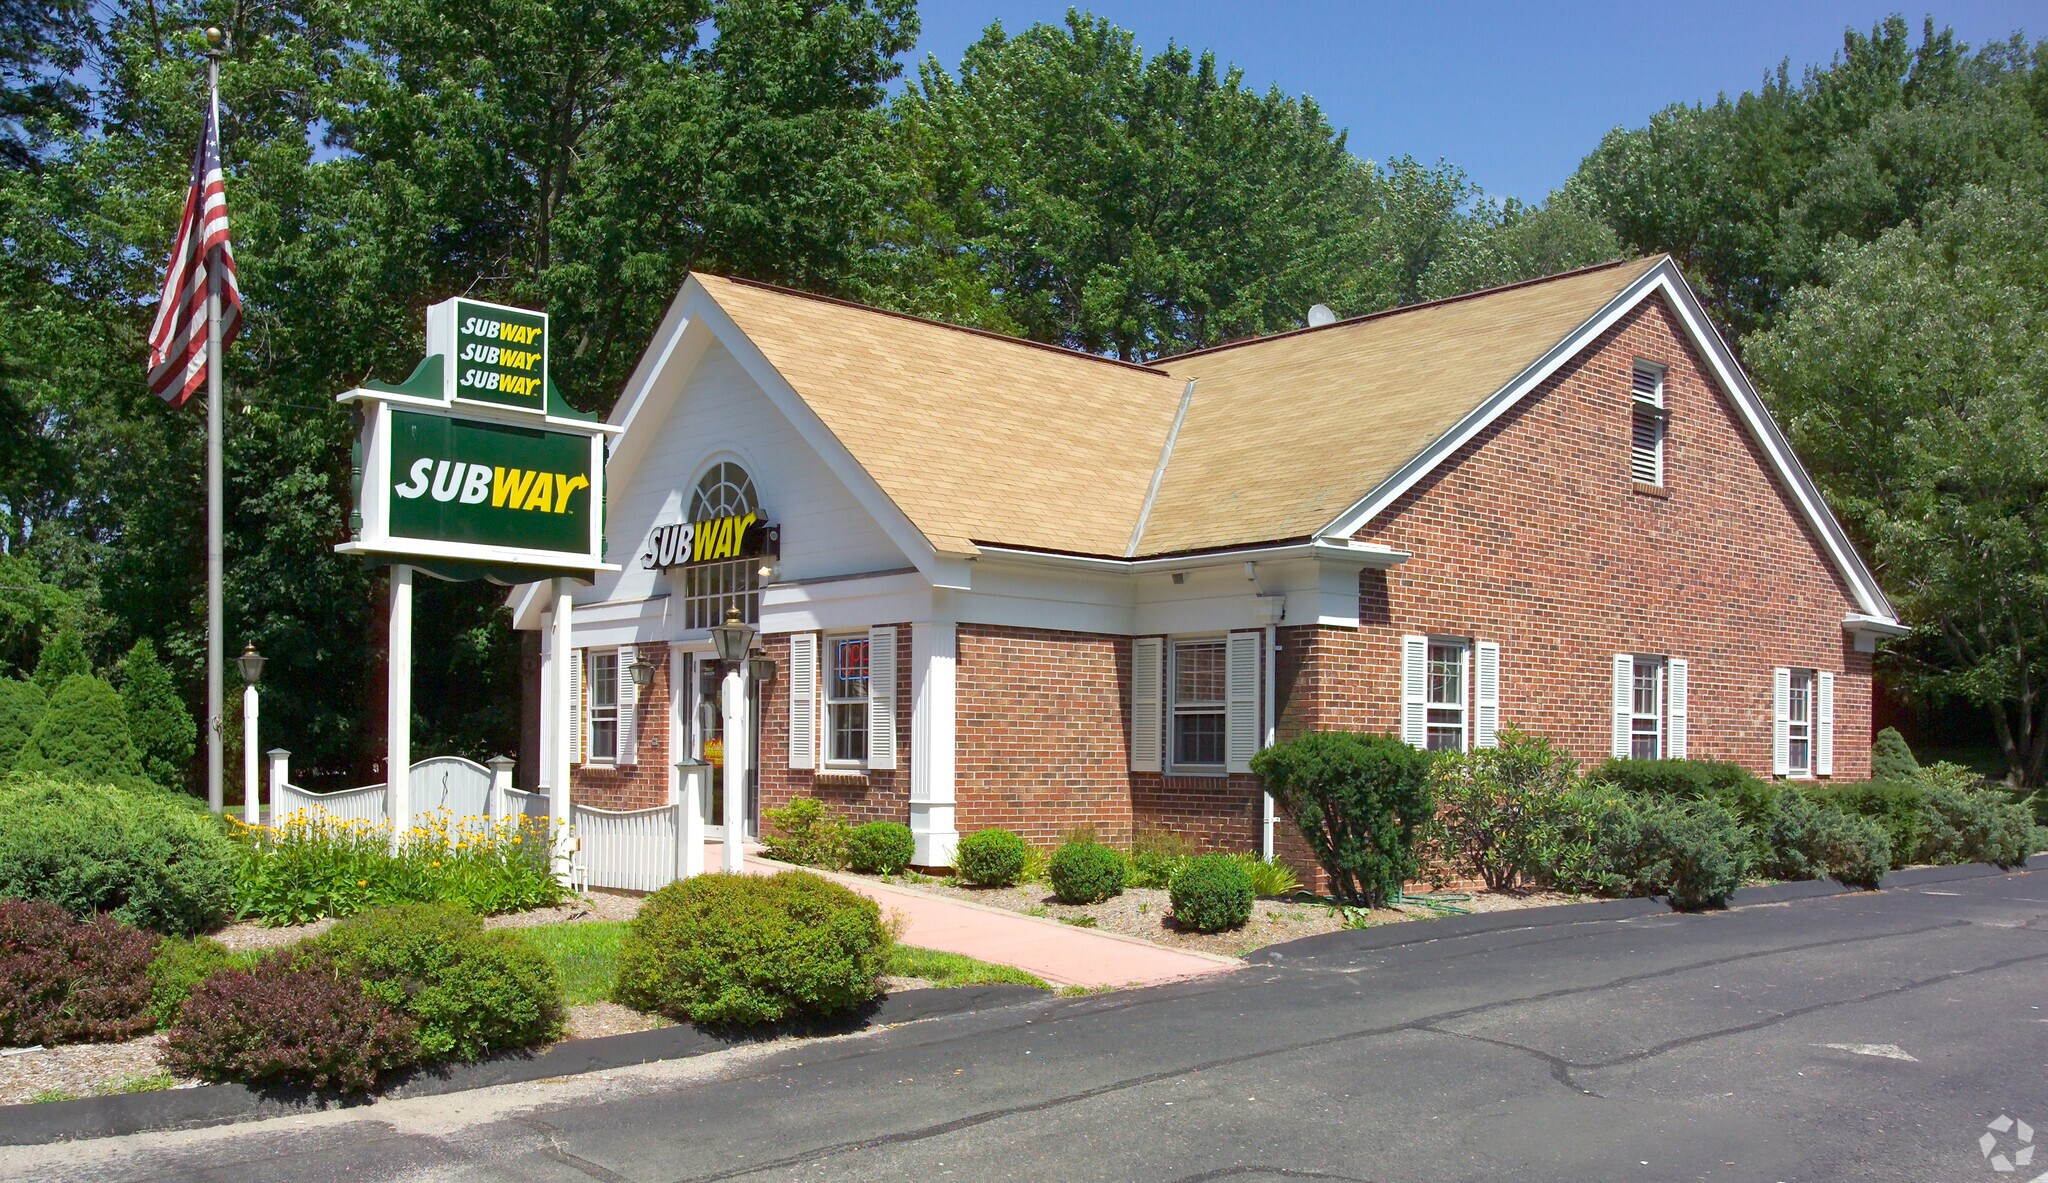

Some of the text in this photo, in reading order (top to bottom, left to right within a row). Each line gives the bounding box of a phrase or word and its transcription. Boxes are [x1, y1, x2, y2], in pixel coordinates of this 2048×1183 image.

[460, 317, 542, 344] SUBWAY
[460, 343, 542, 370] SUBWAY
[460, 369, 541, 396] SUBWAY
[395, 457, 590, 514] SUBWAY
[641, 510, 758, 569] SUBWAY
